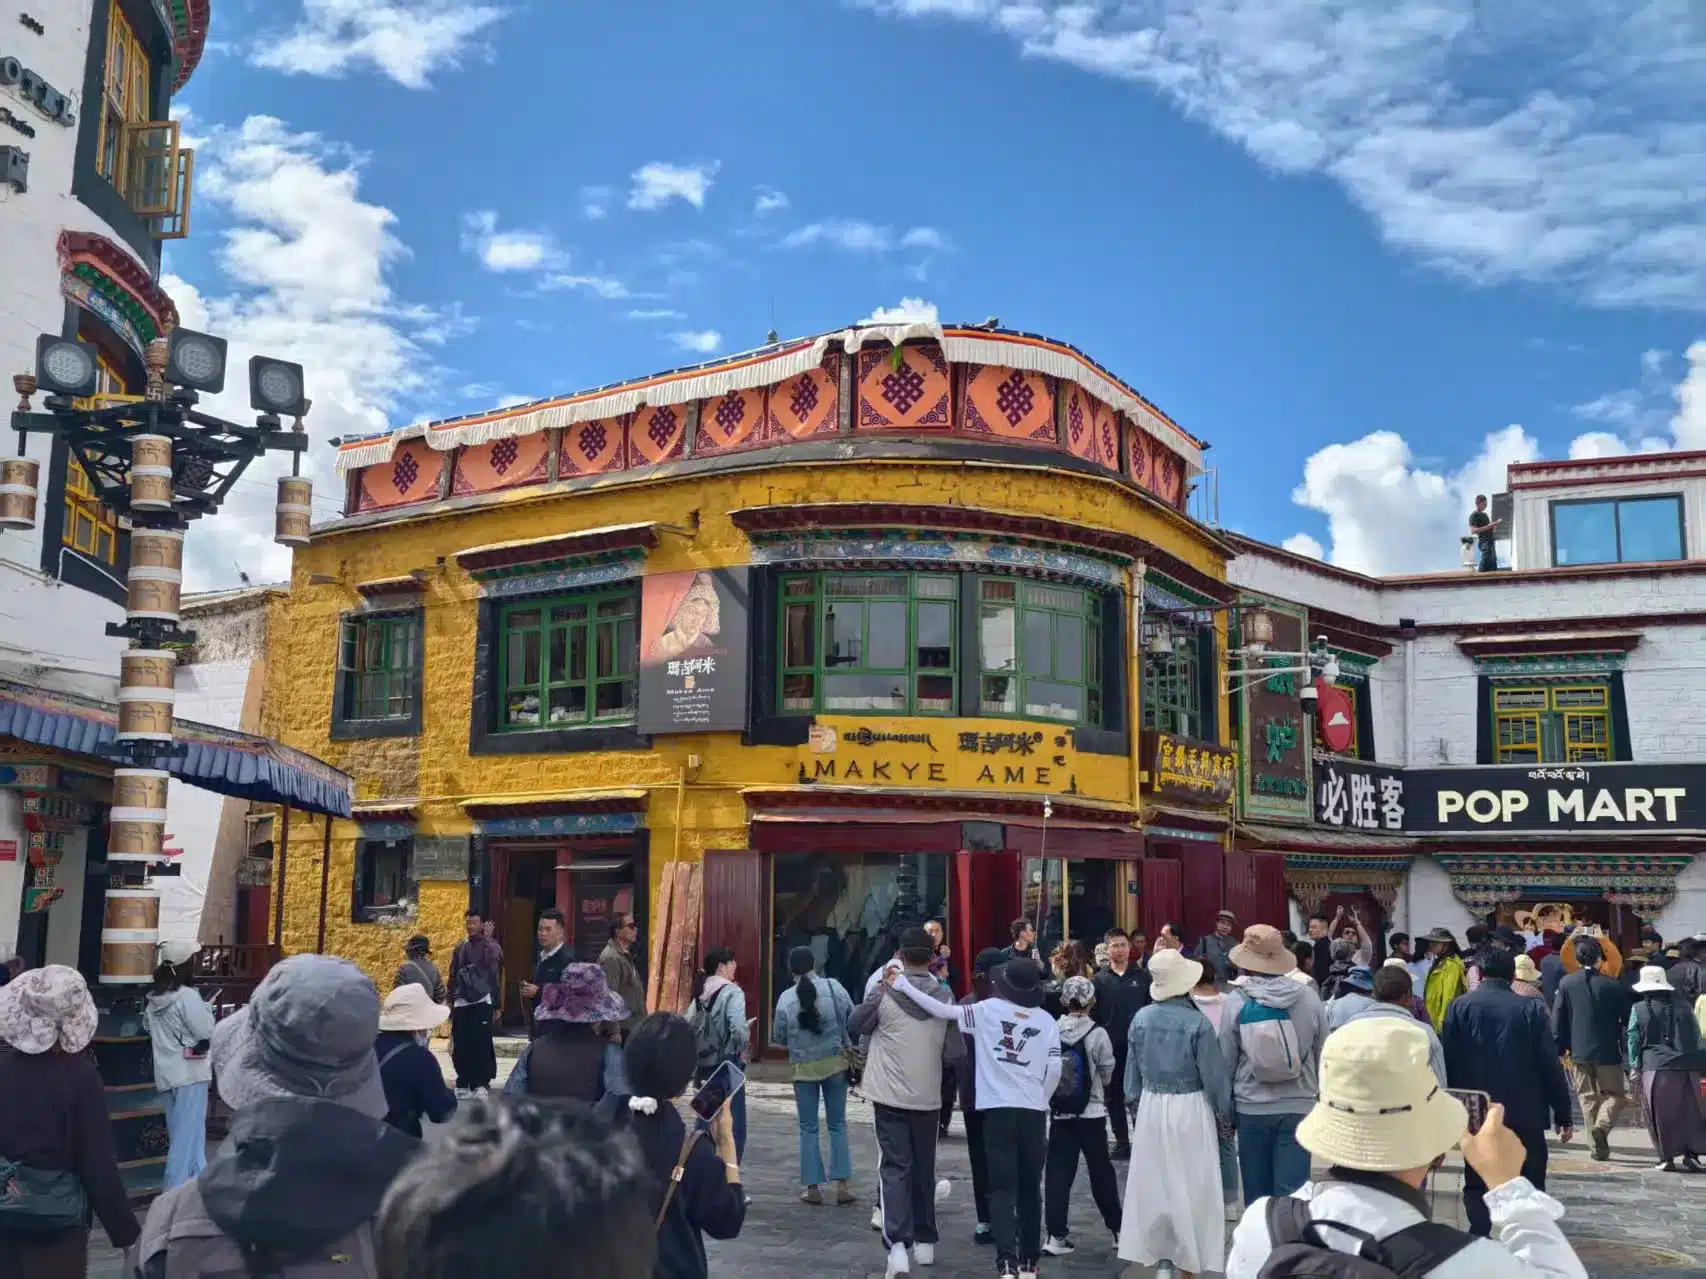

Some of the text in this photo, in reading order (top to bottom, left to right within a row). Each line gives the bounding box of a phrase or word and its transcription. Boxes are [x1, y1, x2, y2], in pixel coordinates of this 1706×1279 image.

[815, 759, 1051, 785] MAKYE AME
[1321, 767, 1405, 829] 必胜客
[1437, 787, 1686, 823] POP MART
